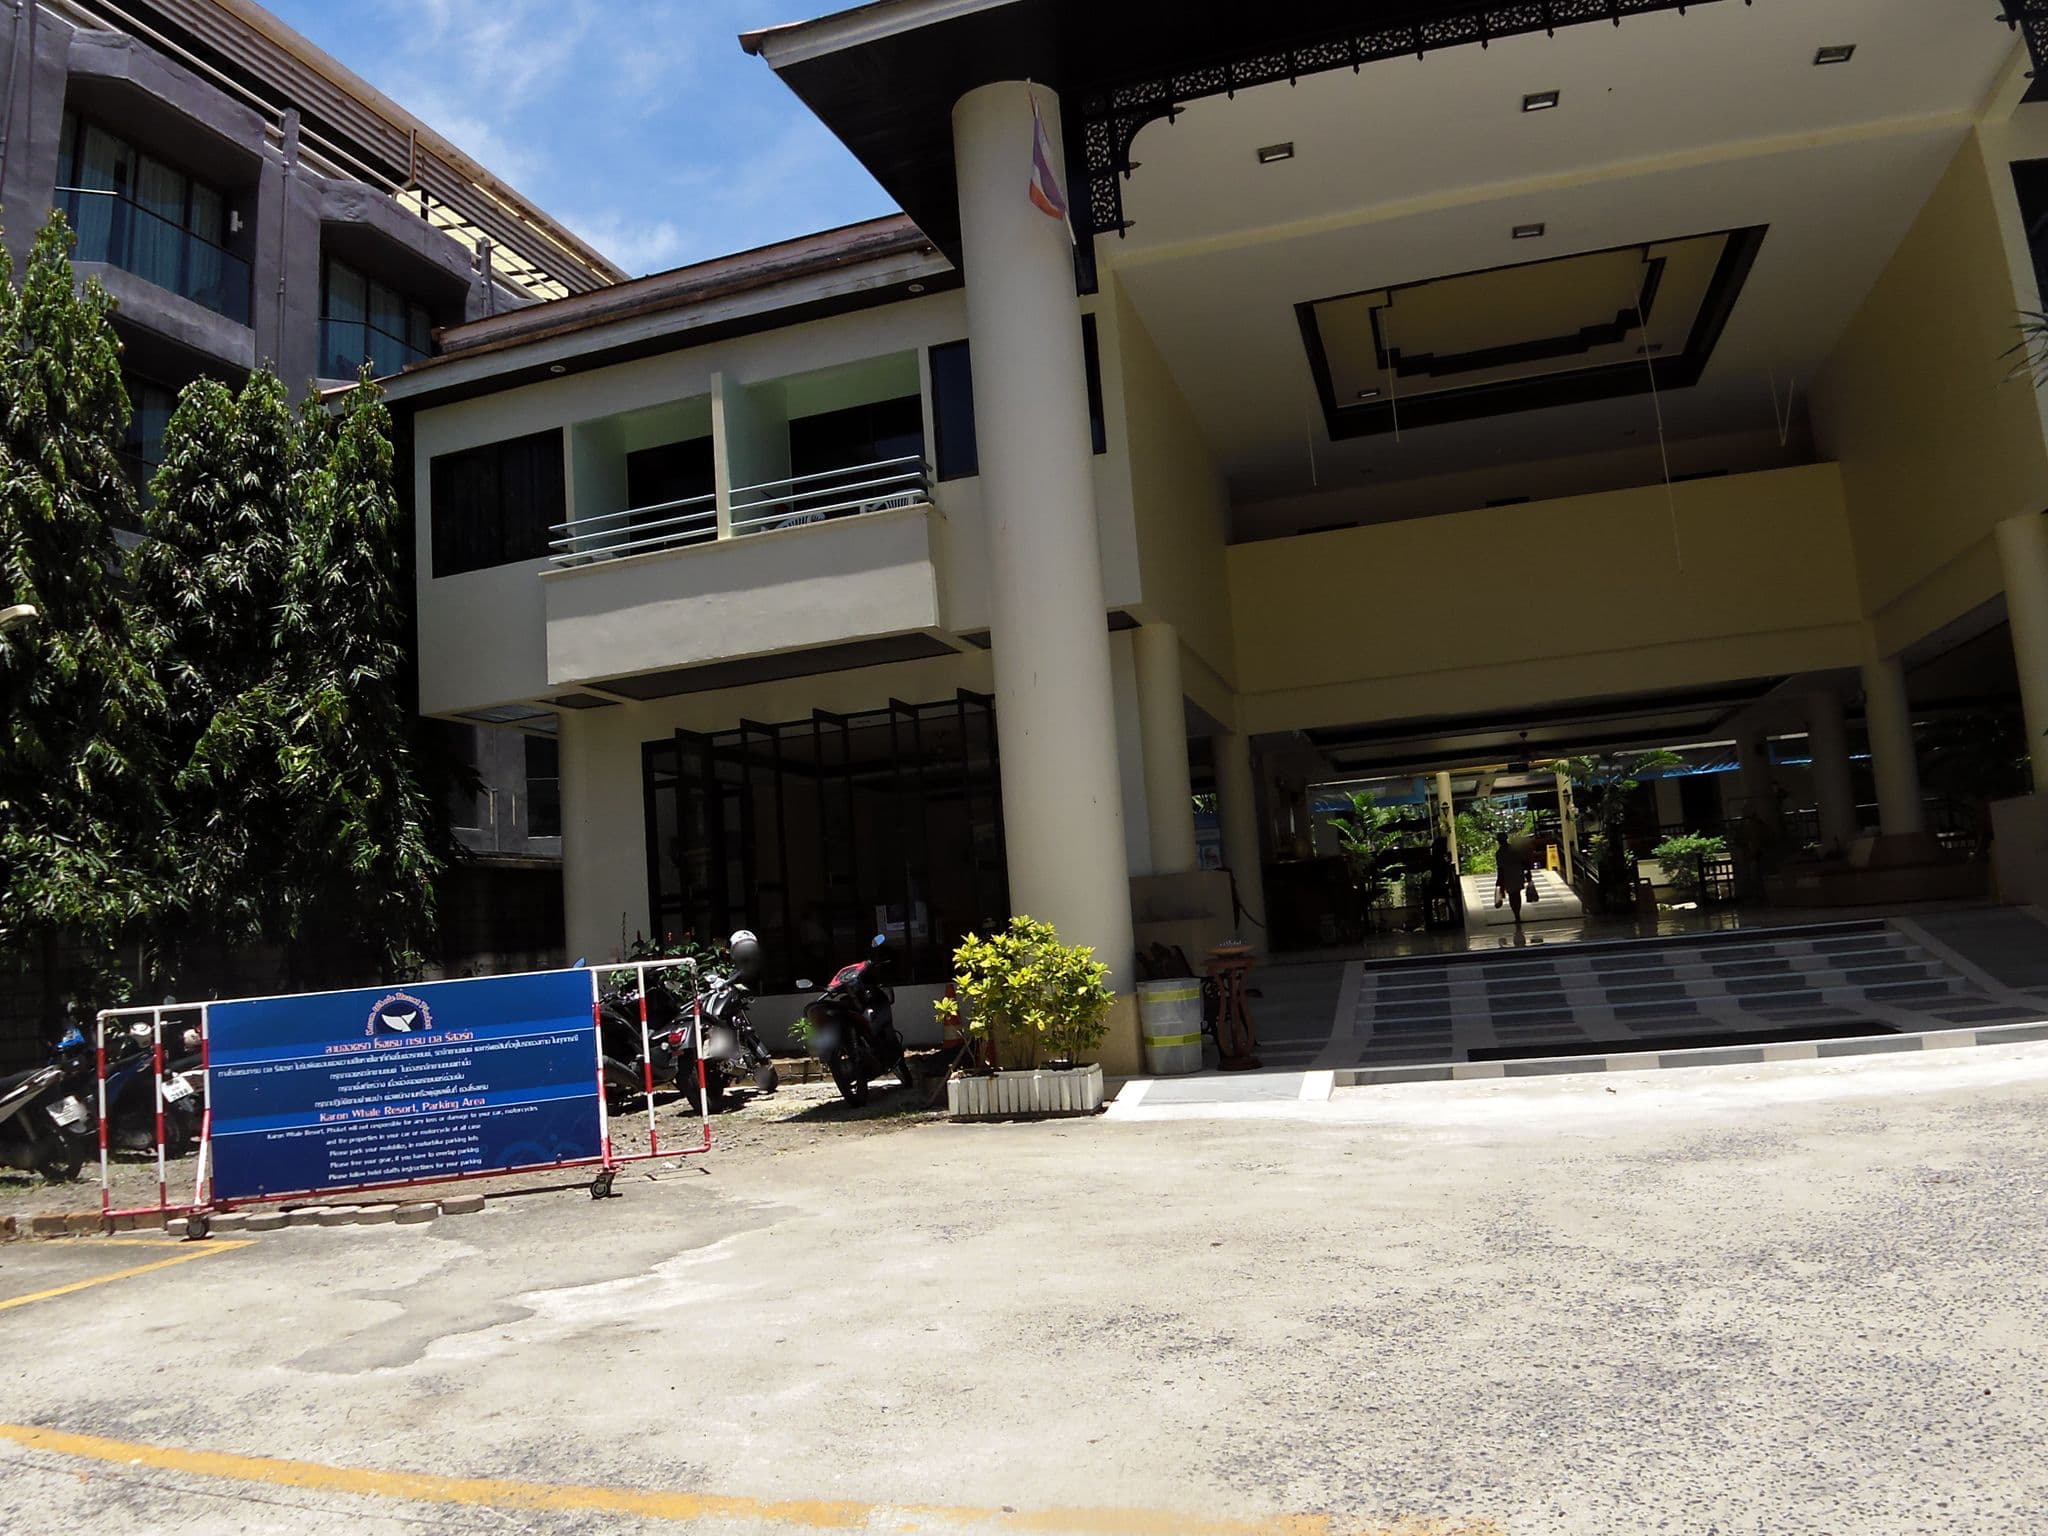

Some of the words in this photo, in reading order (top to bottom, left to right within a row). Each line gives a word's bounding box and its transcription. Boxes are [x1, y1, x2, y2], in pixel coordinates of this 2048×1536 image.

[320, 1112, 349, 1122] Karon
[352, 1108, 381, 1118] Whale
[384, 1104, 419, 1115] Resort,
[422, 1099, 459, 1111] Parking
[462, 1097, 485, 1107] Area
